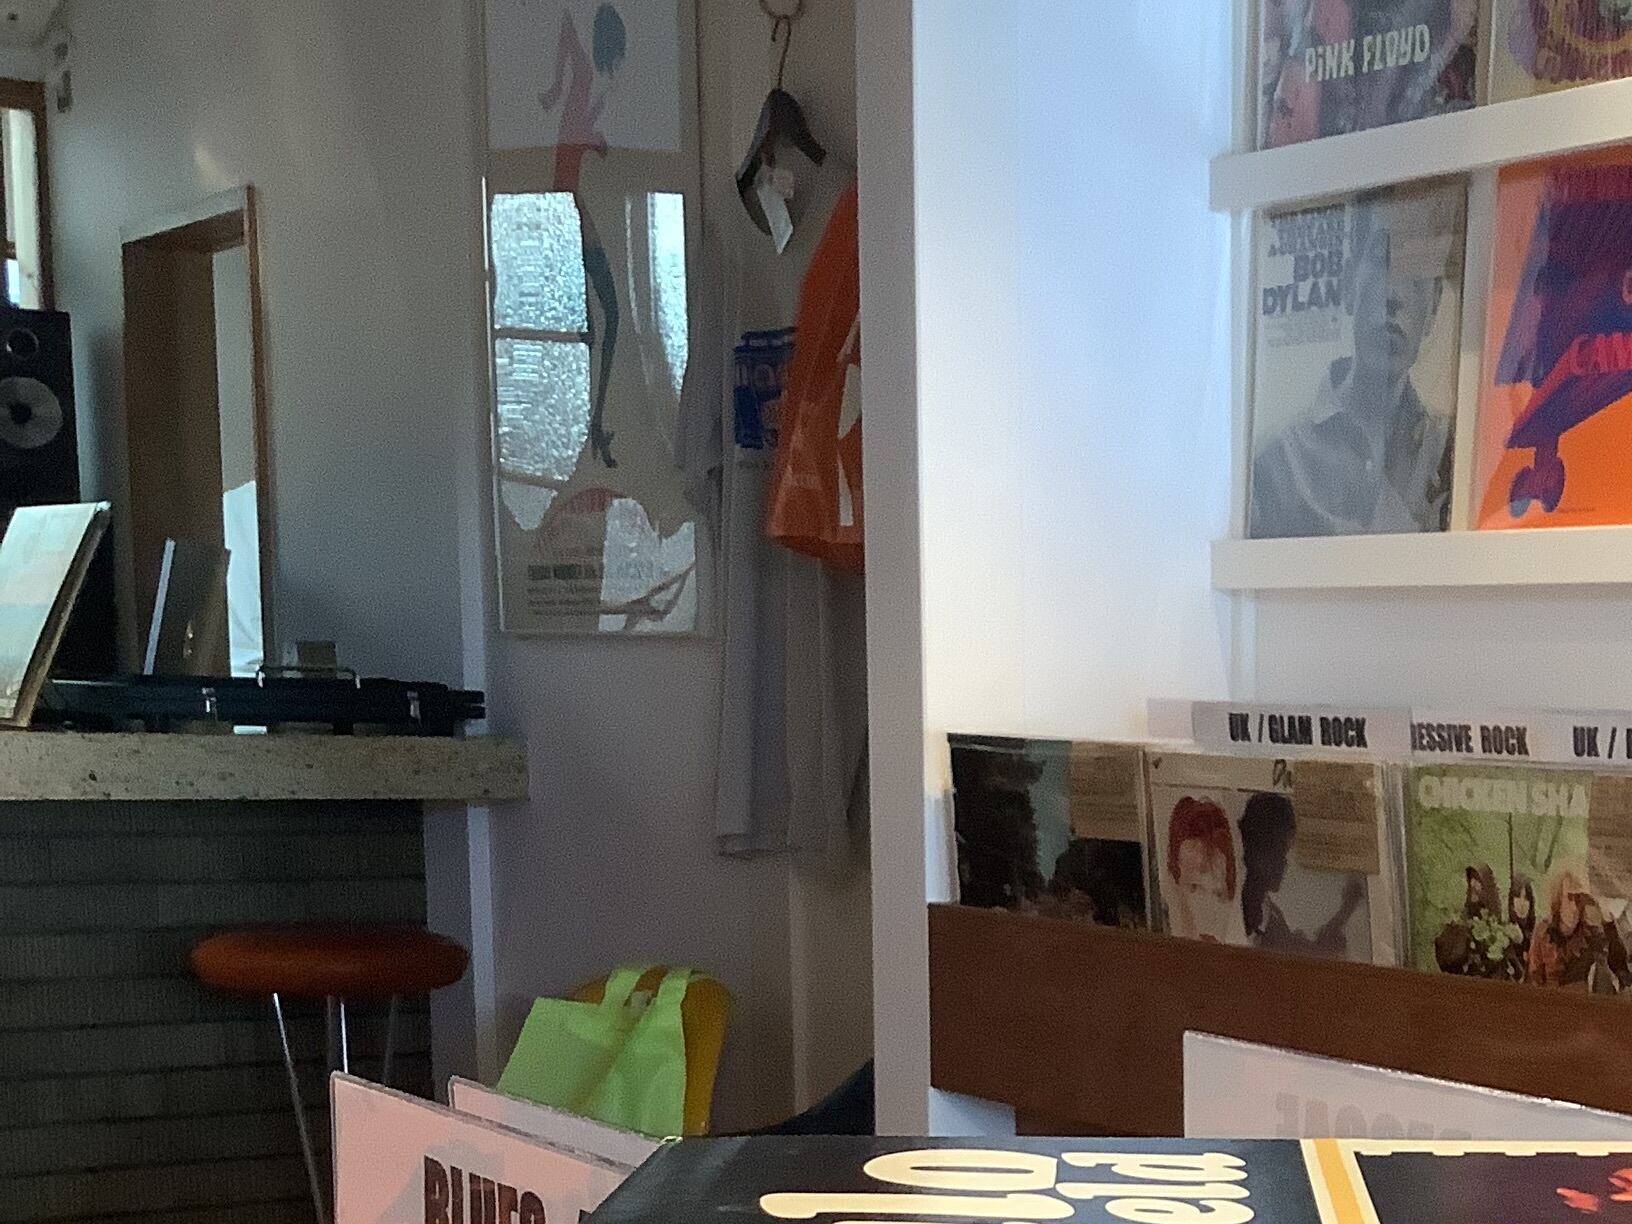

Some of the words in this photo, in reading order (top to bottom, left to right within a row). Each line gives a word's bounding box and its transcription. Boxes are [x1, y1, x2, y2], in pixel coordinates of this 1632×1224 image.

[1362, 24, 1431, 73] FLOYD
[1262, 278, 1343, 316] DYLAN
[1228, 712, 1252, 743] UK
[1319, 716, 1368, 749] ROCK
[1480, 725, 1530, 757] ROCK
[1572, 725, 1600, 758] UK
